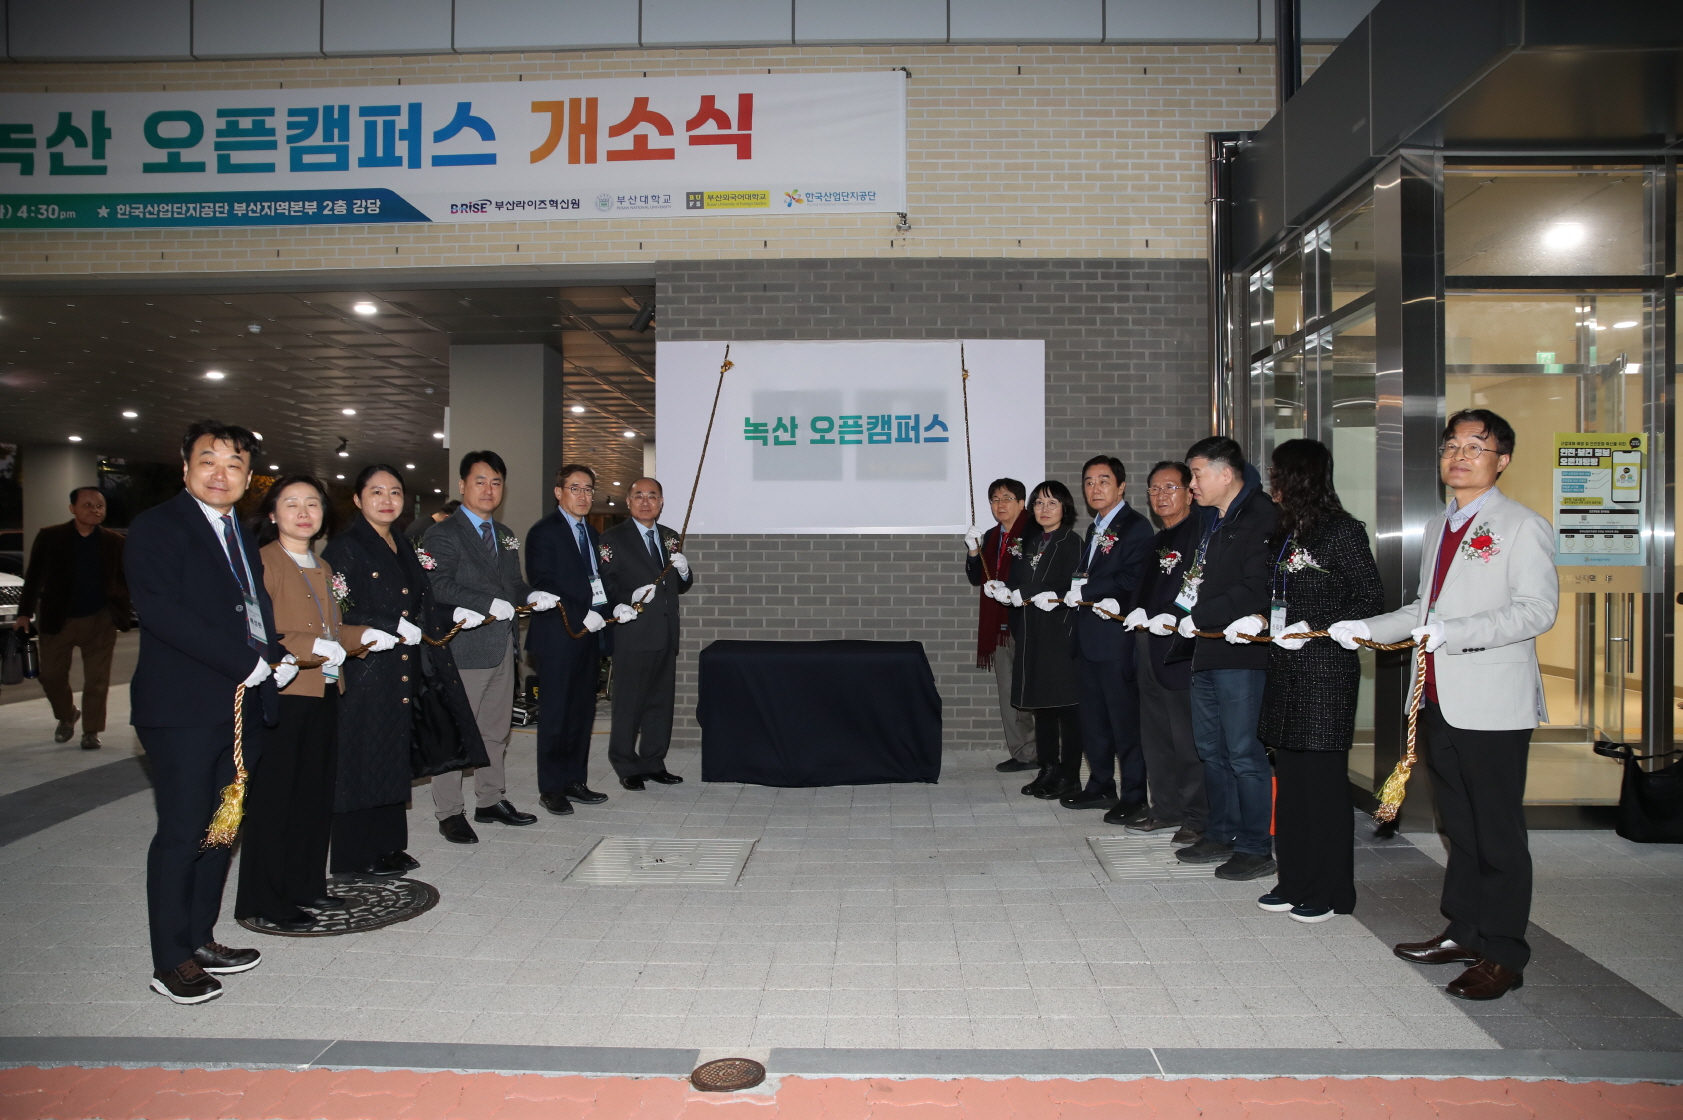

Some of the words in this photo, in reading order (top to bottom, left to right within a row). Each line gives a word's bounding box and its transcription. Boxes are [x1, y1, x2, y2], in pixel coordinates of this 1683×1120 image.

[142, 102, 497, 174] 오픈캠퍼스
[529, 93, 754, 165] 개소식
[616, 194, 672, 205] 부산대학교
[706, 193, 767, 202] 부산외국어대학교
[805, 191, 877, 202] 한국산업단지공단
[16, 204, 76, 219] 4:30pm
[116, 201, 229, 218] 한국산업단지공단
[233, 200, 318, 217] 부산지역본부
[322, 200, 347, 216] 2층
[352, 199, 381, 215] 강당
[494, 198, 580, 211] 부산라이즈혁신원
[743, 416, 798, 447] 녹산
[810, 413, 950, 445] 오픈캠퍼스
